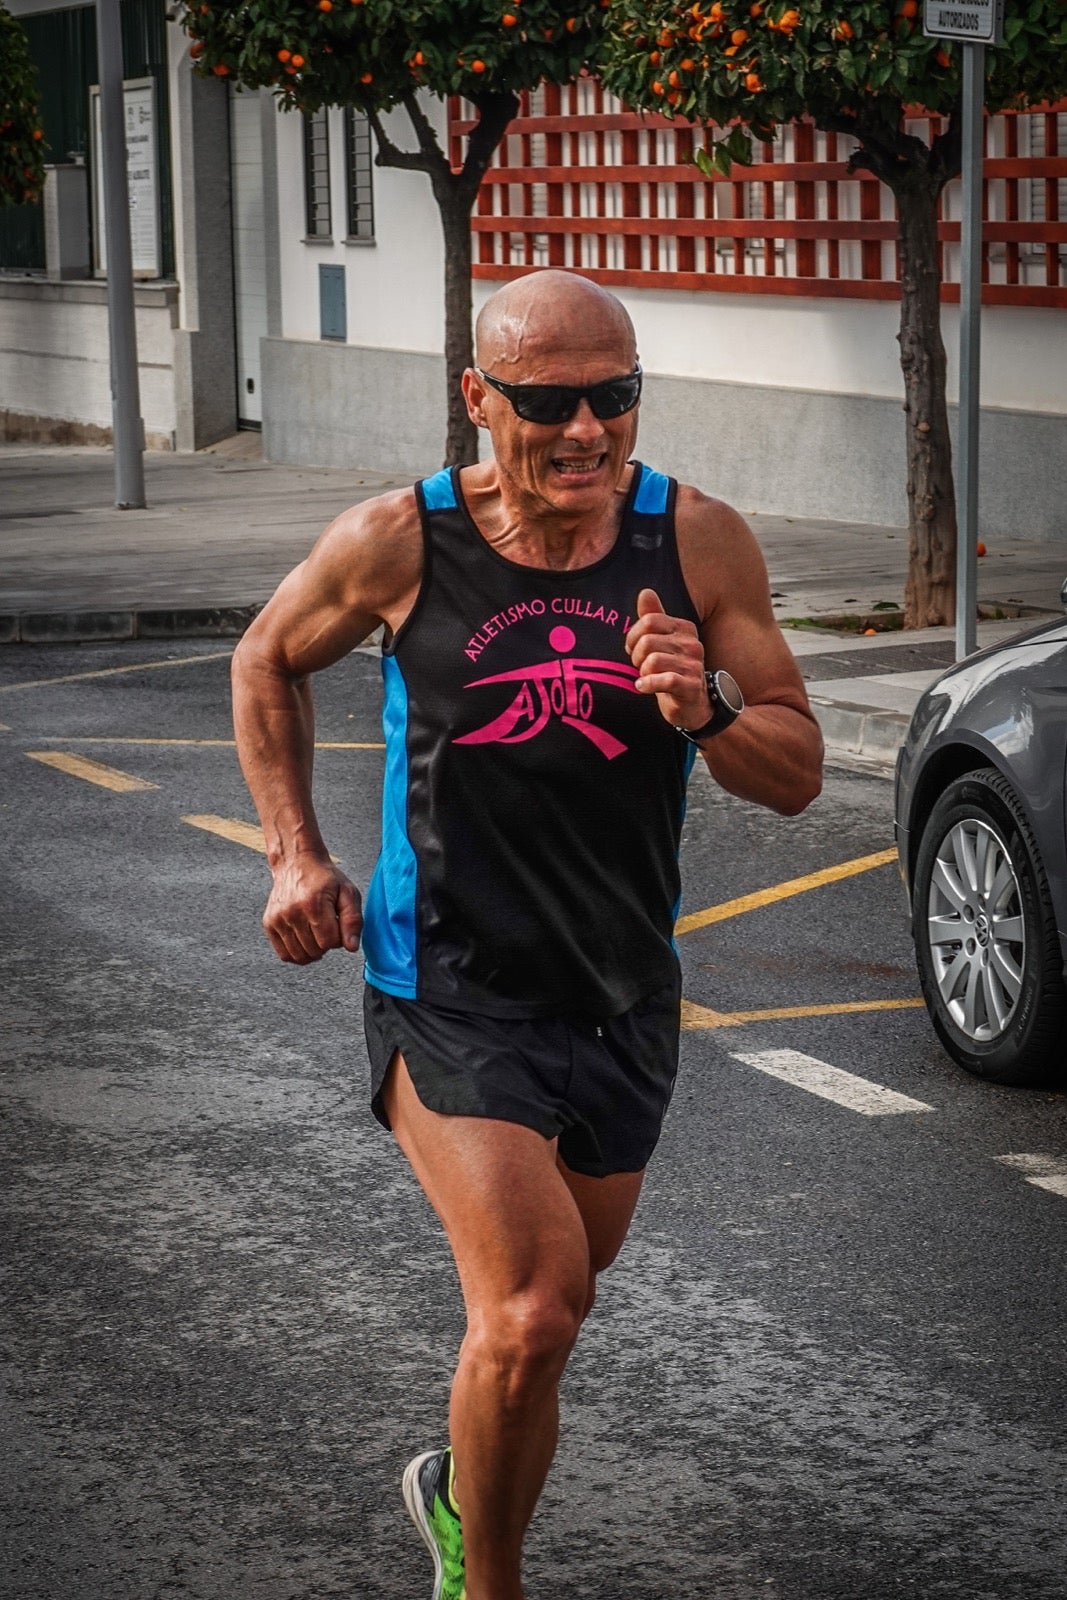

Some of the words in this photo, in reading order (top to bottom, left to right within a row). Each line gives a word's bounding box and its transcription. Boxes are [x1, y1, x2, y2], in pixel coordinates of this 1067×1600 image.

[938, 10, 979, 31] AUTORIZADOS
[464, 599, 546, 663] ATLETISMO
[550, 598, 619, 626] CULLAR
